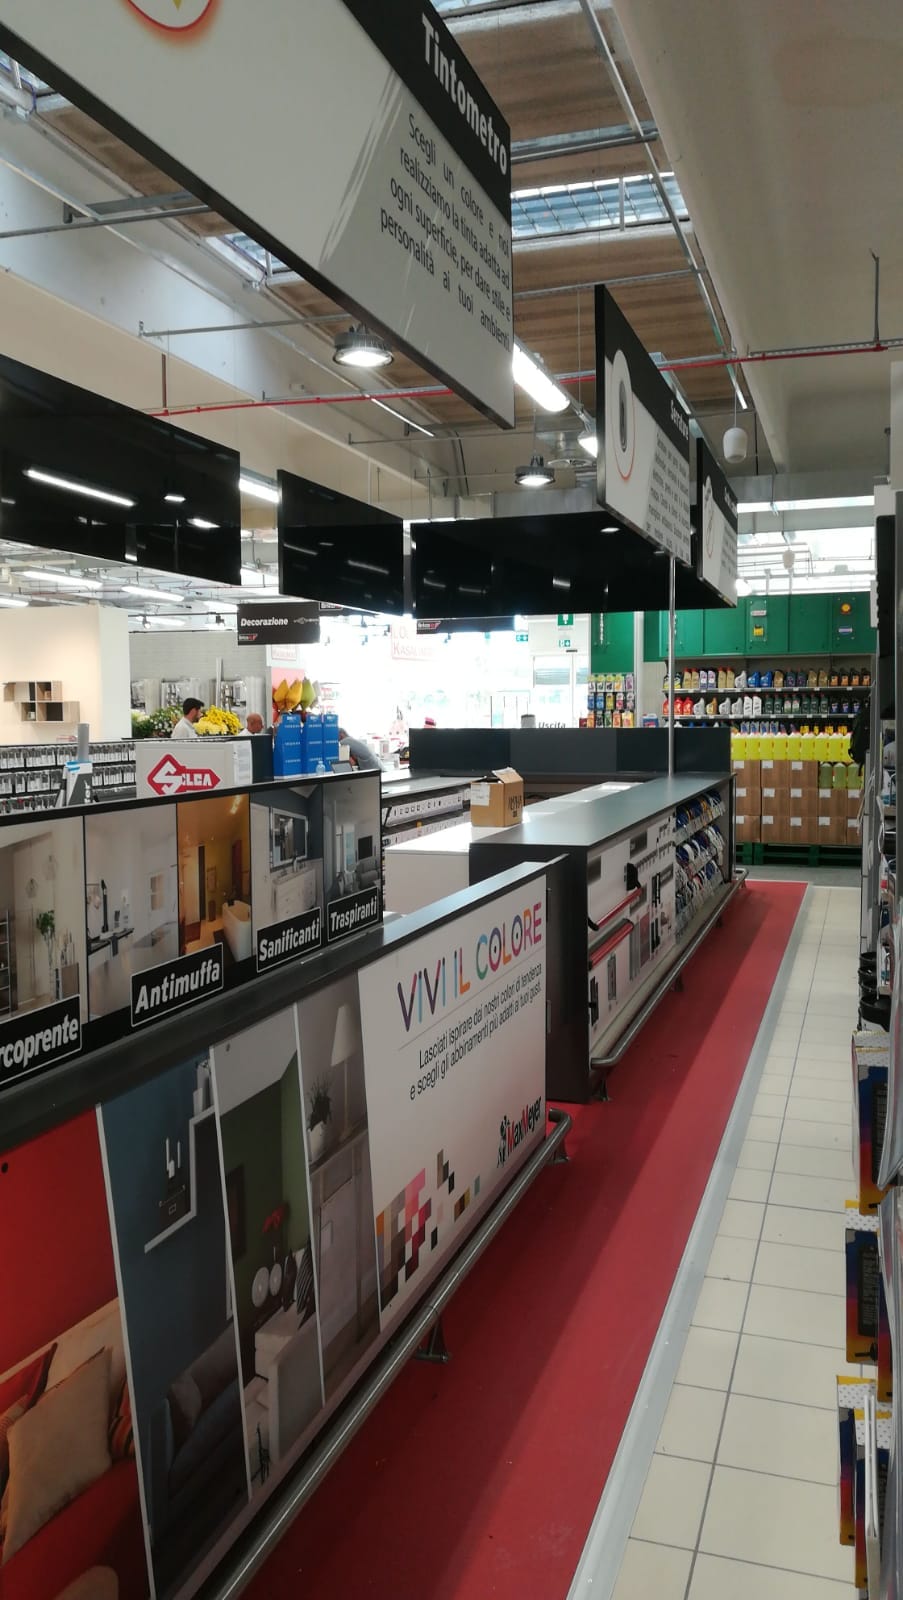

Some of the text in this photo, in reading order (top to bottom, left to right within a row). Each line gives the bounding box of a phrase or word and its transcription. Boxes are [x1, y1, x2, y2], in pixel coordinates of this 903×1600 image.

[422, 12, 507, 175] Tintometro
[400, 147, 510, 291] realizziamo la tinta adatta ad
[409, 113, 509, 258] Scegli un colore e noi
[380, 207, 510, 352] personalità ai tuoi ambienti
[390, 176, 511, 322] ogni superficie, per dare stile e
[240, 616, 289, 627] Decorazione
[259, 917, 321, 962] Sanificanti
[330, 896, 378, 933] Traspiranti
[397, 902, 542, 1032] VIVI IL COLORE
[134, 958, 221, 1014] Antimuffa
[419, 963, 542, 1069] Lasciati ispirare dai nostri colori di tendenza
[410, 1085, 416, 1101] e
[417, 1060, 440, 1095] scegli
[441, 1053, 449, 1080] gli
[450, 1020, 488, 1067] abbinamenti
[489, 1012, 499, 1038] più
[499, 1000, 514, 1026] adatti
[520, 987, 530, 1009] tuoi
[507, 1096, 541, 1157] MaxMeyer
